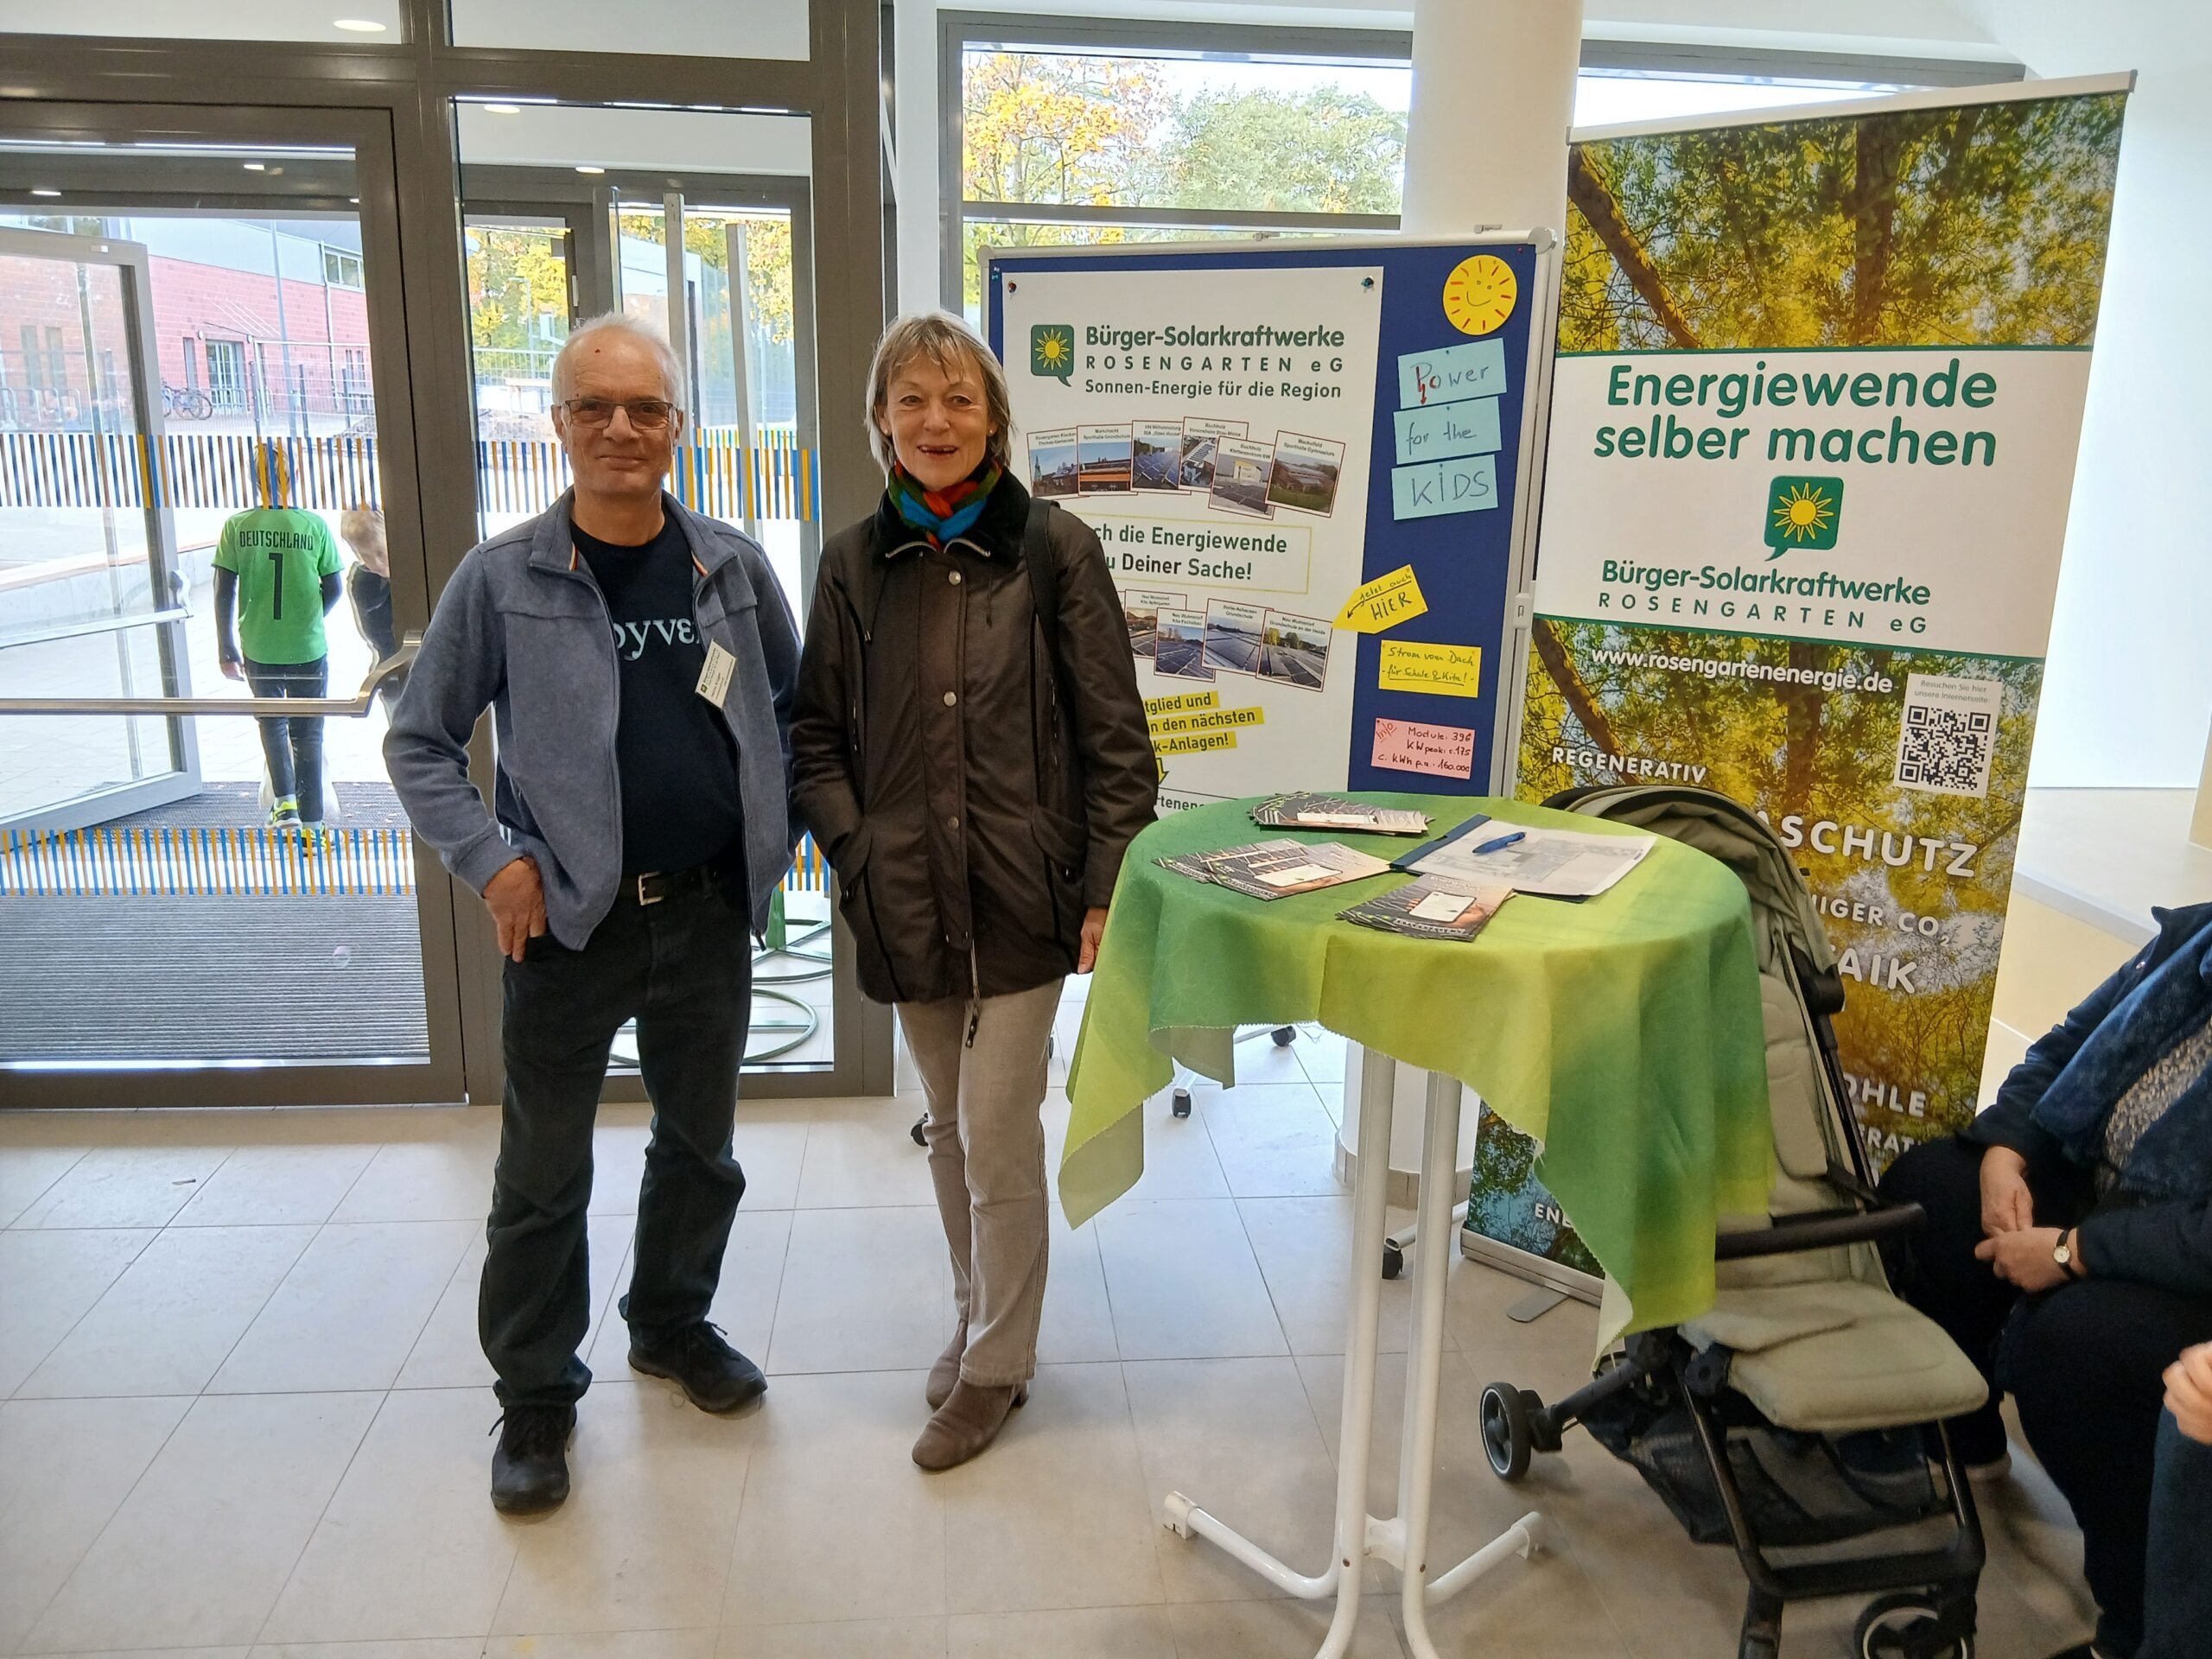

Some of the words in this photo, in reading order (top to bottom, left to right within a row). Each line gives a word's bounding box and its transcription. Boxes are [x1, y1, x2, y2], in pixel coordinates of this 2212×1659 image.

[1086, 325, 1344, 351] Bürger-Solarkraftwerke
[1086, 355, 1293, 372] ROSENGARTEN
[1409, 362, 1490, 393] Power
[1085, 379, 1212, 399] Sonnen-Energie
[1218, 380, 1243, 397] für
[1248, 381, 1274, 397] die
[1281, 383, 1342, 401] Region
[1607, 358, 1997, 418] Energiewende
[1406, 422, 1430, 456] for
[1443, 420, 1478, 442] the
[1593, 414, 1751, 461] selber
[1767, 416, 1997, 467] machen
[239, 530, 314, 551] DEUTSCHLAND
[1119, 524, 1145, 543] die
[1152, 526, 1287, 553] Energiewende
[1122, 552, 1182, 575] Deiner
[1187, 558, 1252, 580] Sache!
[269, 552, 283, 620] 1
[1389, 573, 1412, 588] auch
[1602, 559, 1931, 606] Bürger-Solarkraftwerke
[1599, 592, 1865, 629] ROSENGARTEN
[1890, 616, 1927, 634] eG
[1388, 646, 1421, 659] Strom
[1447, 650, 1474, 667] Dach
[1403, 667, 1430, 678] Schule
[1592, 650, 1894, 694] www.rosengartenenergie.de
[1920, 679, 1957, 690] Besuchen
[1972, 684, 1987, 693] hier
[1144, 696, 1182, 715] tglied
[1185, 691, 1211, 708] und
[1150, 722, 1159, 733] n
[1162, 717, 1187, 731] den
[1191, 710, 1255, 728] nächsten
[1154, 732, 1229, 752] k-Anlagen!
[1551, 747, 1707, 783] REGENERATIV
[1758, 810, 1979, 878] SCHUTZ
[1836, 947, 1918, 995] AIK
